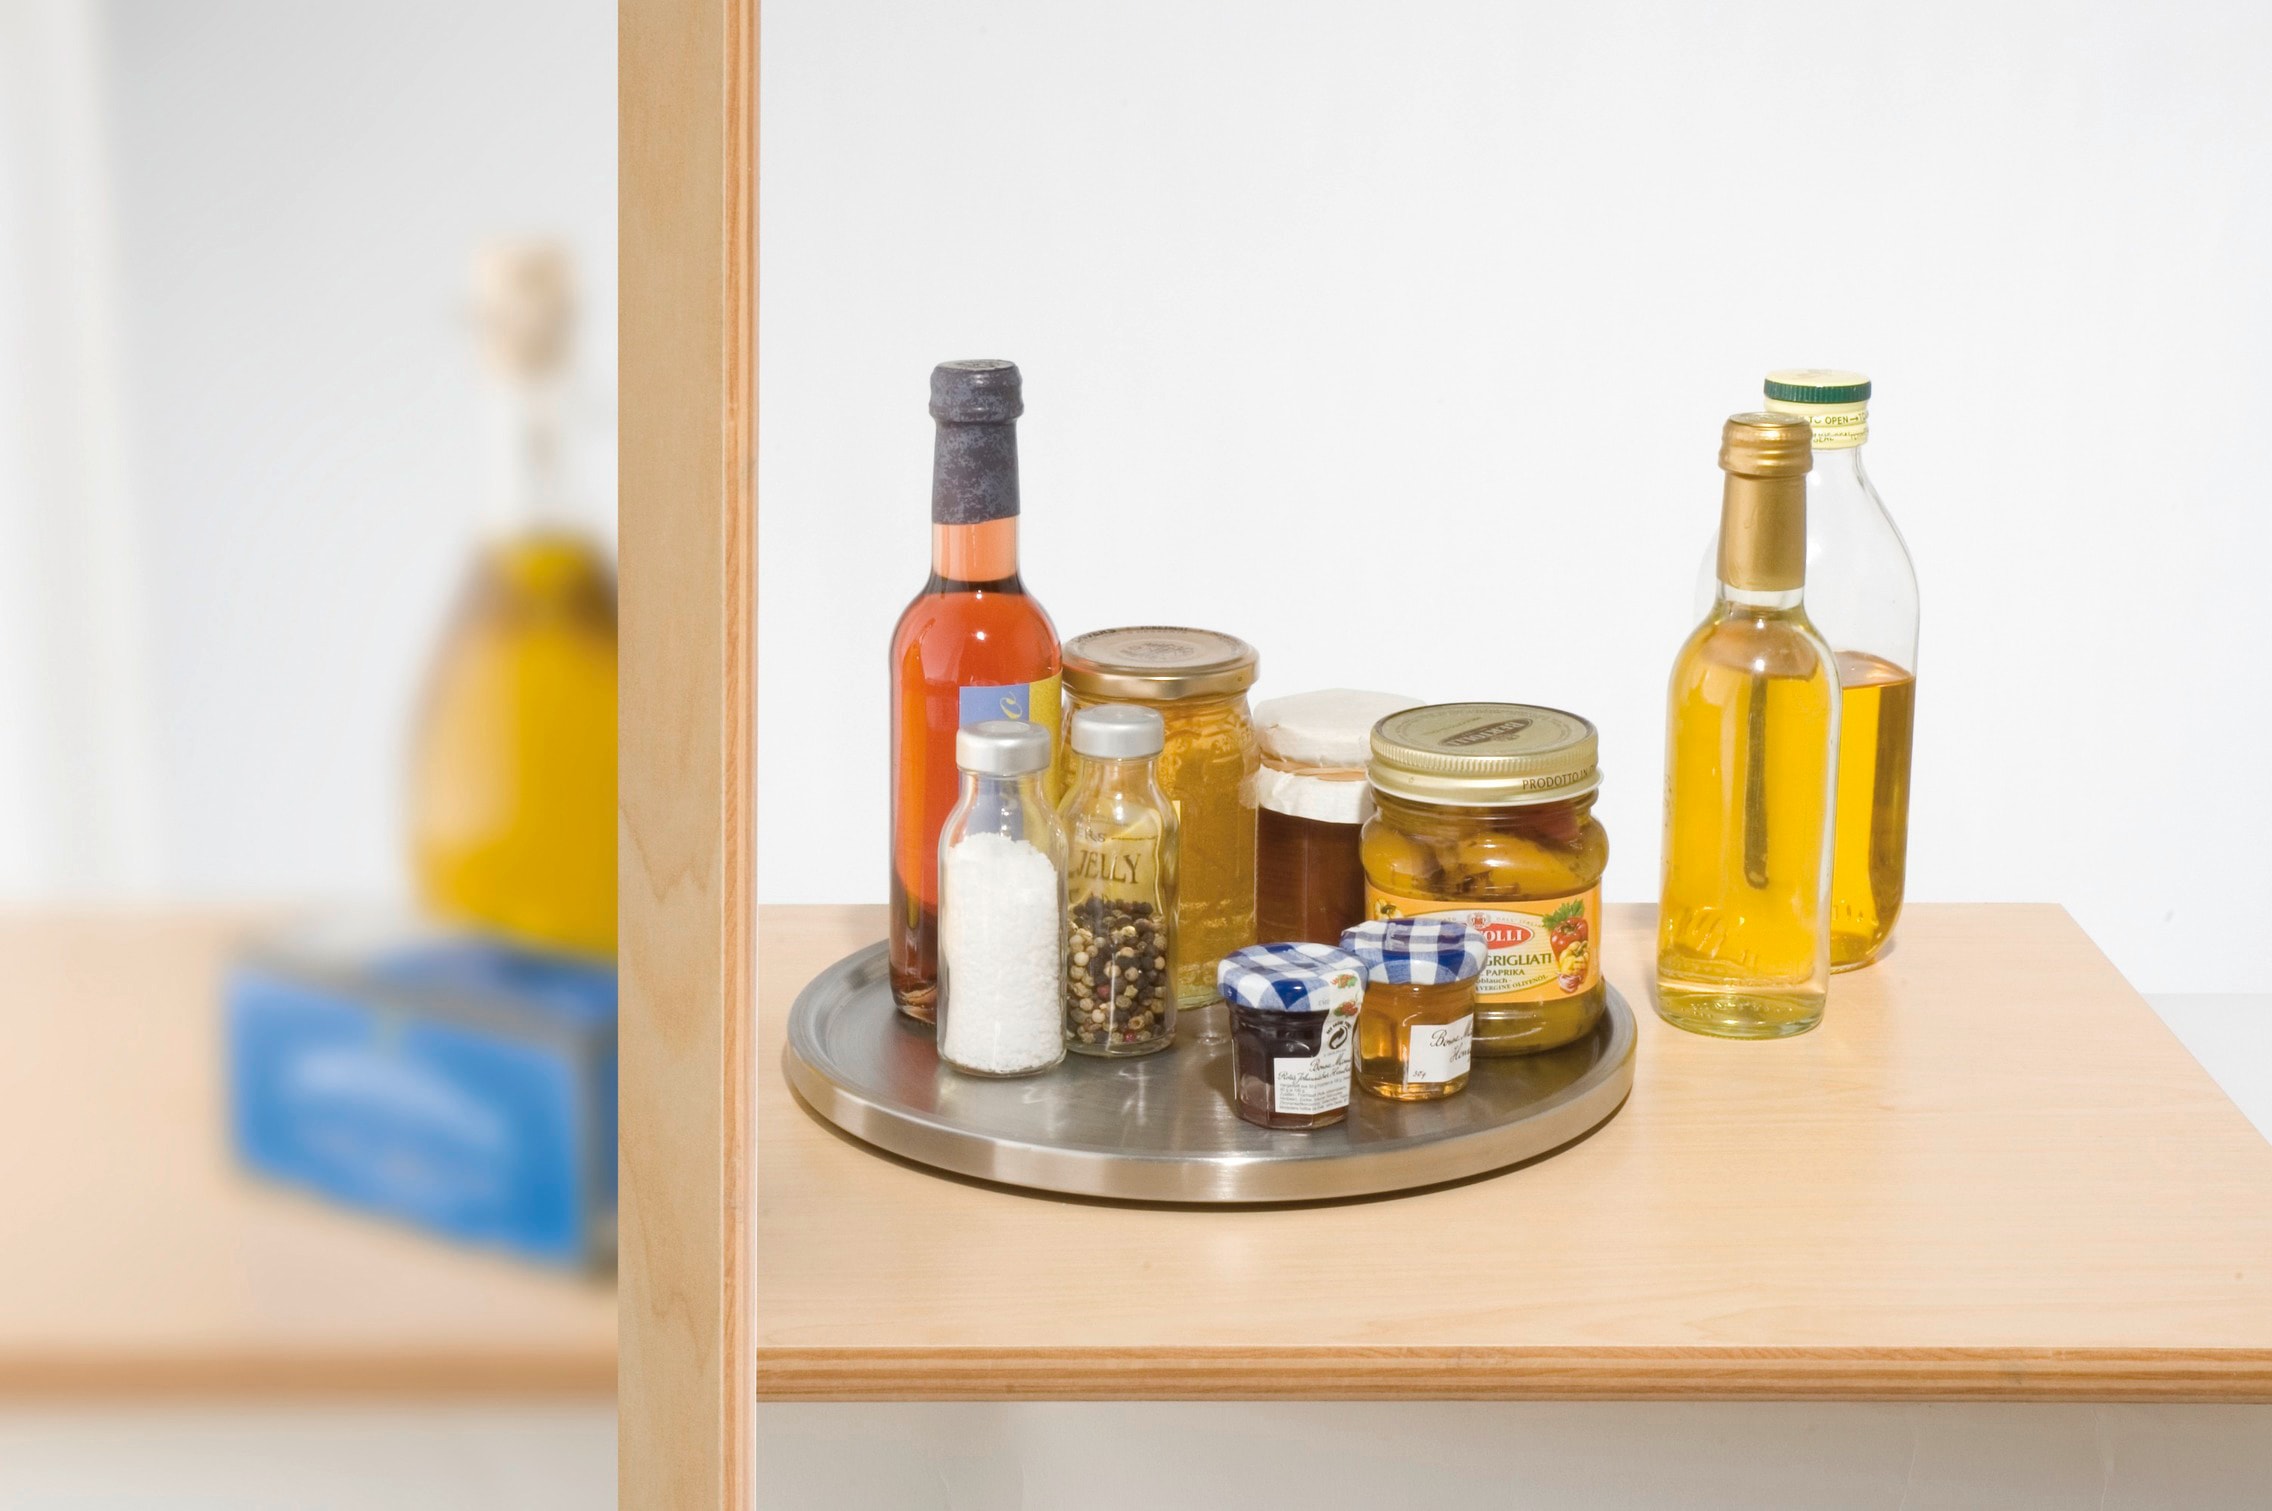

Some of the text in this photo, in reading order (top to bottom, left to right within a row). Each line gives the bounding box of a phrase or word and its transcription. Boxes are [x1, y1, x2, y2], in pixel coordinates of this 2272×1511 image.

[1824, 415, 1849, 425] OPEN
[1522, 772, 1579, 790] PRODOTTO
[1077, 850, 1141, 884] JELLY
[1480, 983, 1512, 992] VERGINE
